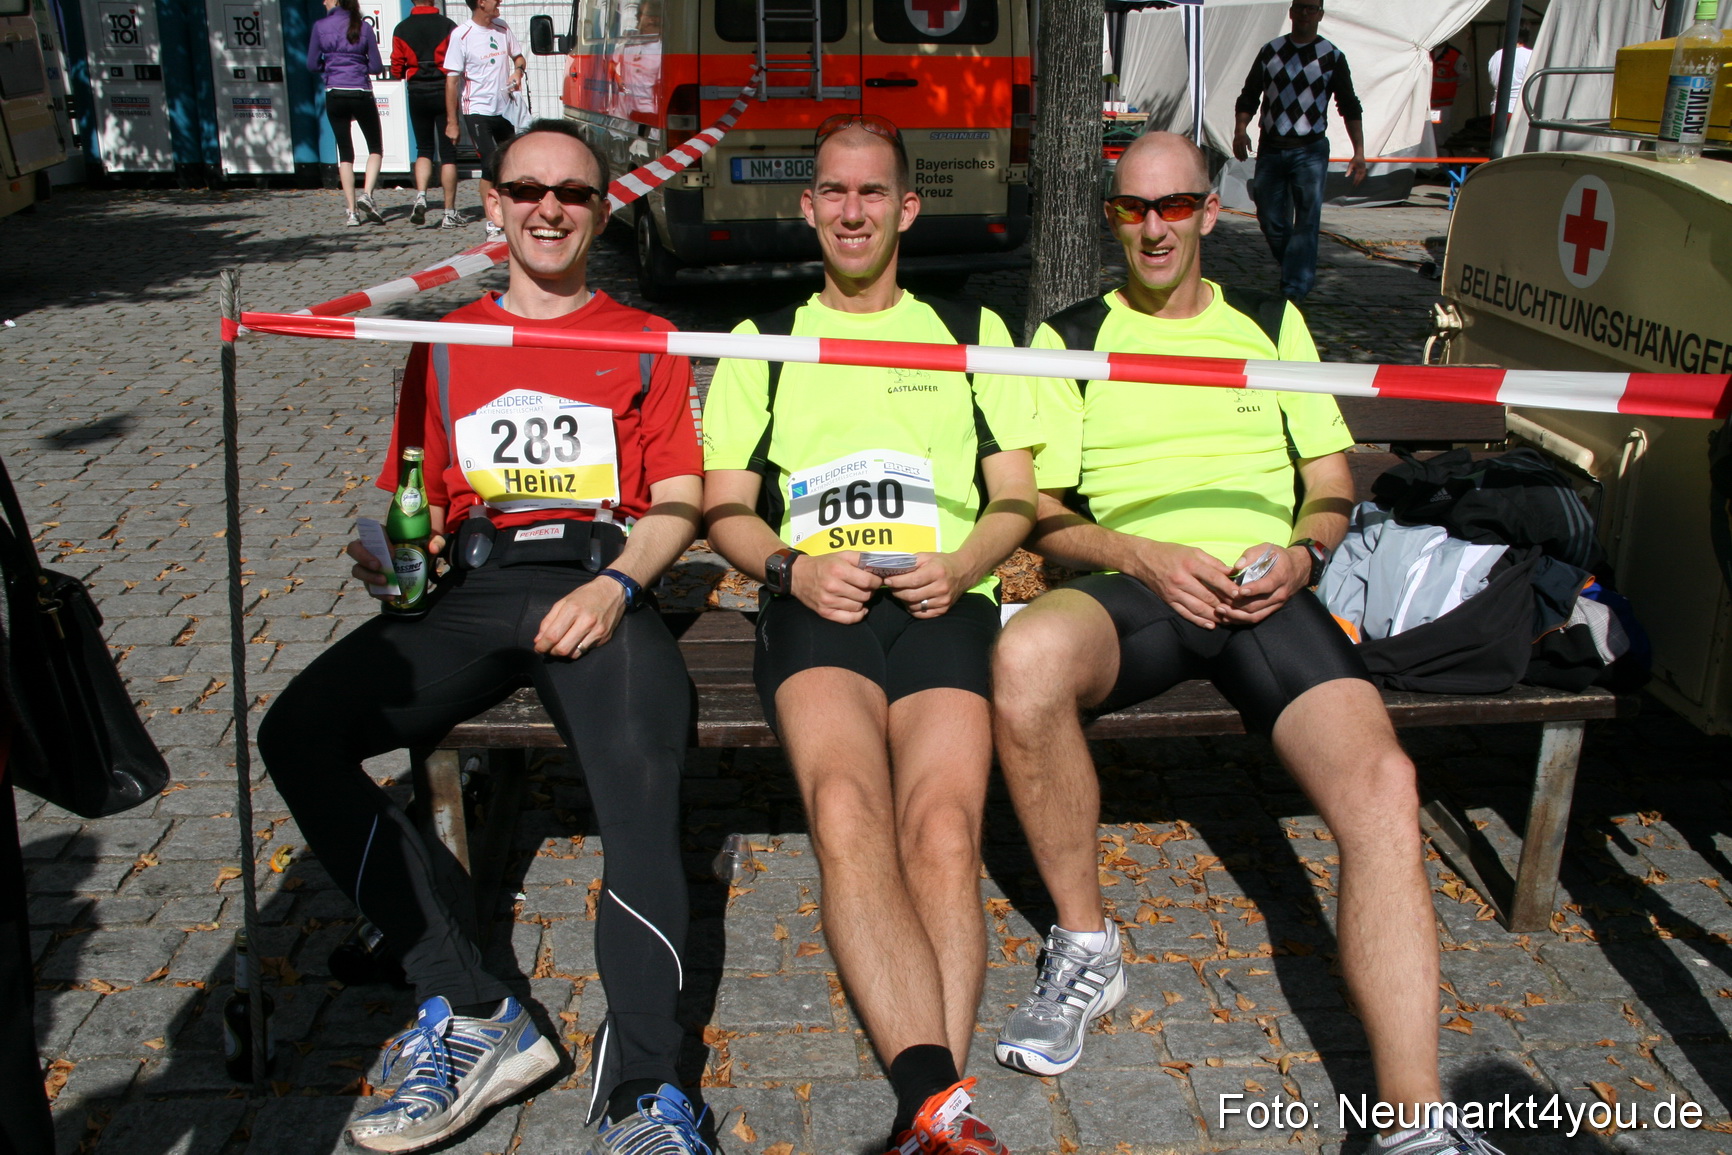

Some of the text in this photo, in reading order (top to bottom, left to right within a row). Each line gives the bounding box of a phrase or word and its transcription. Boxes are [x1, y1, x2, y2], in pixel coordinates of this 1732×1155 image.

[109, 14, 136, 29] TOI
[233, 16, 259, 31] TOI
[111, 30, 139, 44] TOI
[234, 31, 262, 46] TOI
[1682, 88, 1712, 134] ACTIVE
[930, 132, 990, 140] SPRINTER
[751, 160, 814, 177] NM 808
[916, 158, 995, 172] Bayerisches
[916, 173, 954, 184] Rotes
[916, 186, 953, 198] Kreuz
[1237, 405, 1261, 413] OLLI
[490, 414, 581, 465] 283
[504, 469, 577, 494] Heinz
[809, 460, 868, 488] PFLEIDERER
[818, 478, 905, 527] 660
[520, 527, 560, 538] PERFEKTA
[829, 527, 893, 549] Sven
